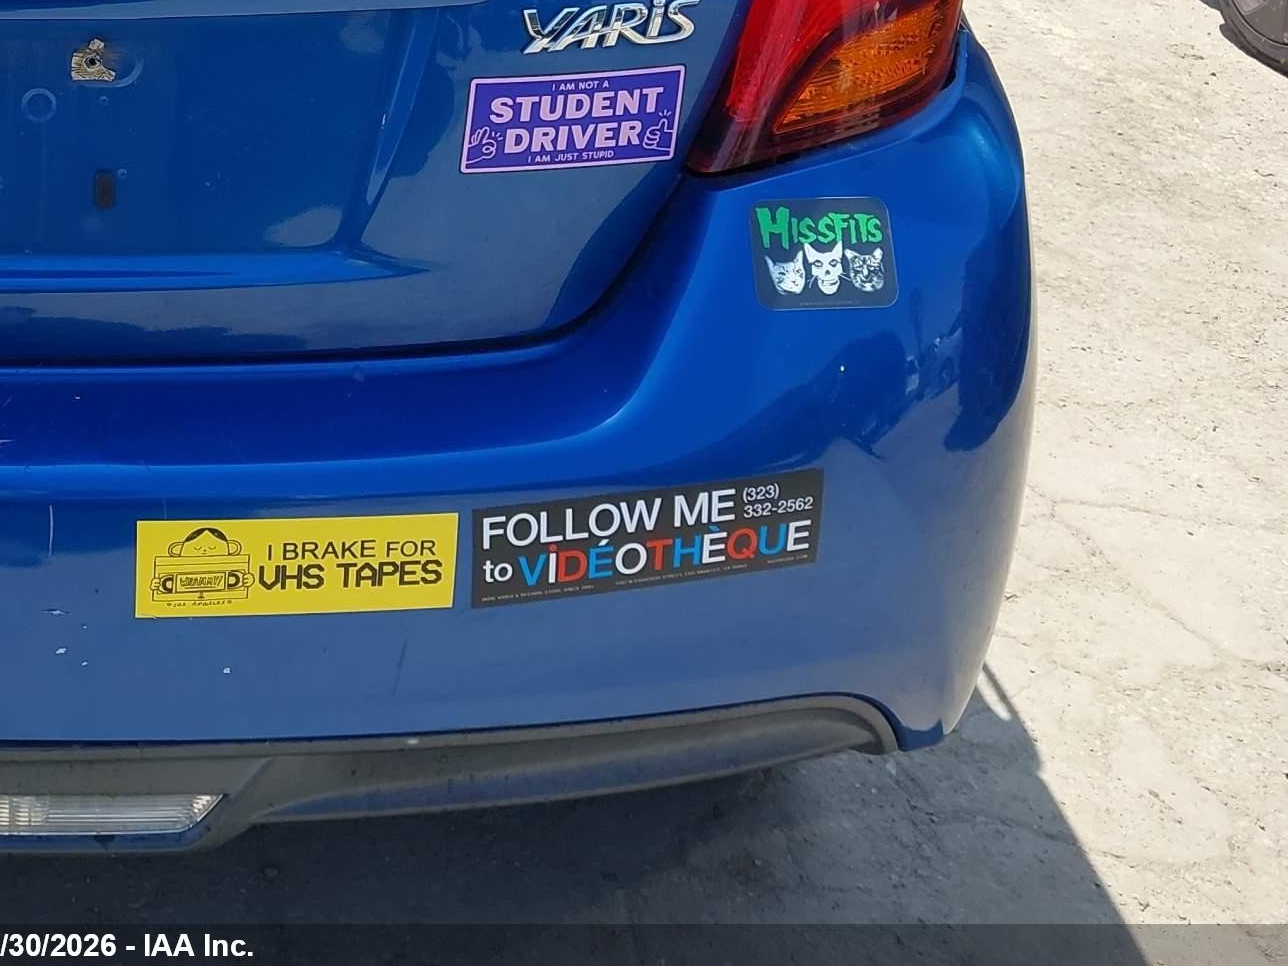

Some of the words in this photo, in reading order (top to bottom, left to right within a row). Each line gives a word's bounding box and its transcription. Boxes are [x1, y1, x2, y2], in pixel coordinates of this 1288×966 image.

[559, 82, 576, 91] AM
[578, 81, 600, 90] NOT
[602, 80, 610, 89] A
[489, 87, 665, 124] STUDENT
[504, 120, 643, 154] DRIVER
[535, 154, 551, 163] AM
[554, 152, 579, 162] JUST
[582, 150, 615, 161] STUPID
[743, 483, 780, 503] (323)
[481, 497, 662, 551] FOLLOW
[674, 488, 737, 528] ME
[743, 496, 814, 520] 332-2562
[267, 543, 273, 562] I
[282, 539, 377, 561] BRAKE
[386, 539, 436, 558] FOR
[258, 563, 325, 591] VHS
[336, 559, 443, 589] TAPES
[483, 559, 513, 583] to
